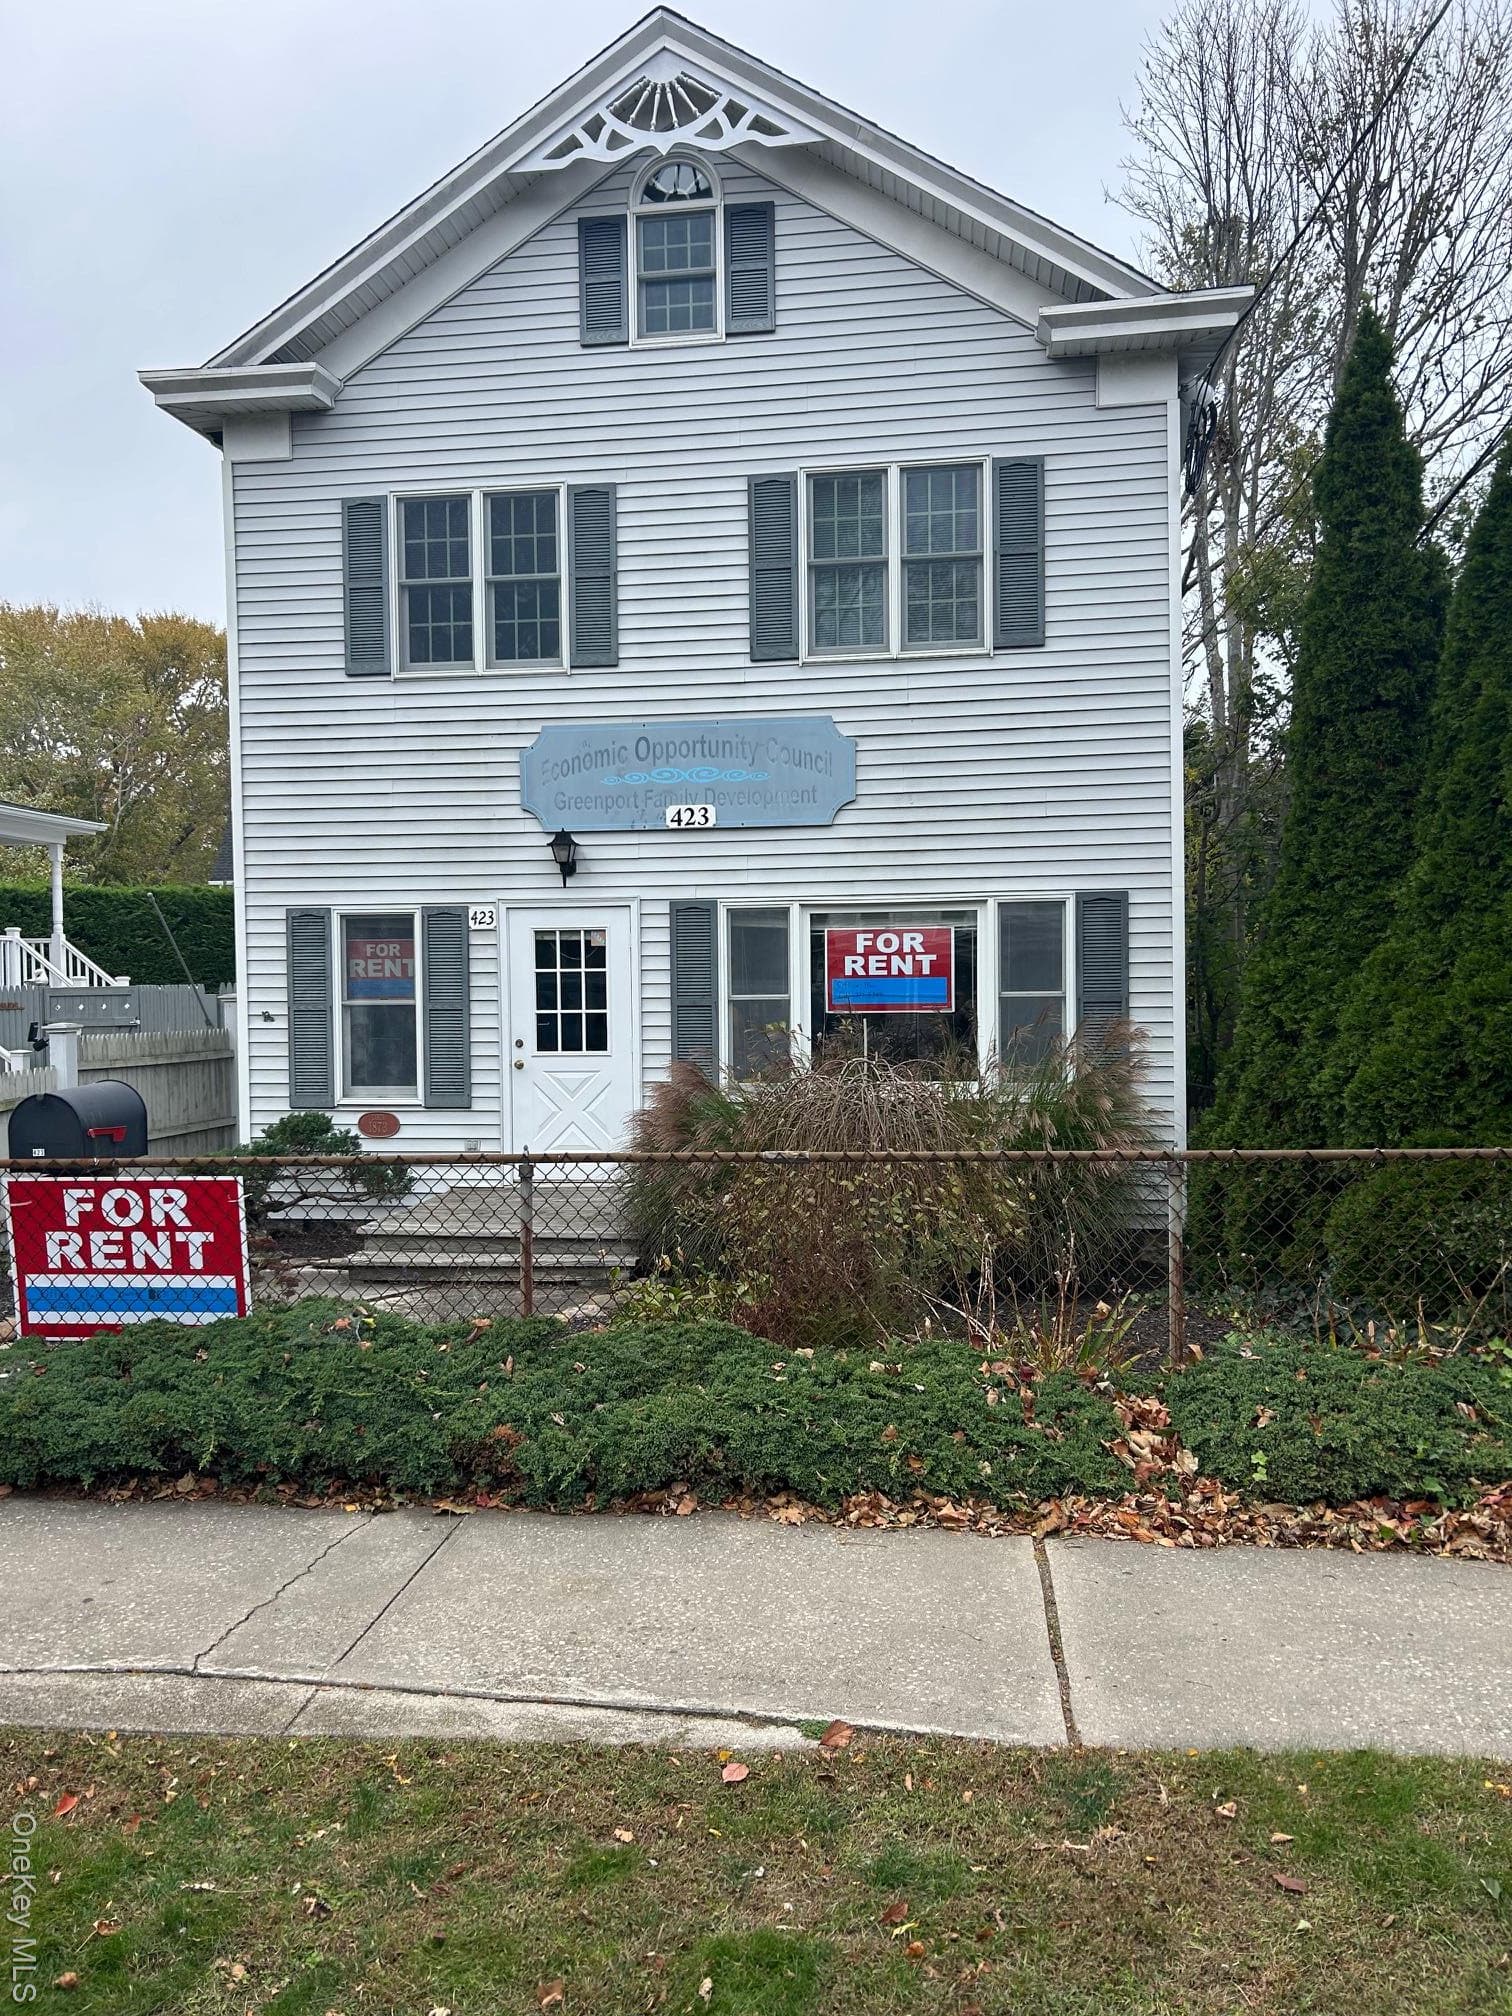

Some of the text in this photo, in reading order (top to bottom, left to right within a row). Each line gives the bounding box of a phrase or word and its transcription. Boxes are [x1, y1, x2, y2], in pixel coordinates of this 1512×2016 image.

[541, 734, 833, 786] Economic Opportunity Council
[554, 790, 639, 814] Greenport
[704, 785, 818, 809] Development
[670, 807, 710, 827] 423
[470, 909, 495, 926] 423
[366, 943, 401, 957] FOR
[856, 932, 925, 954] FOR
[350, 958, 415, 977] RENT
[844, 955, 937, 976] RENT
[63, 1188, 192, 1227] FOR
[45, 1231, 214, 1270] RENT
